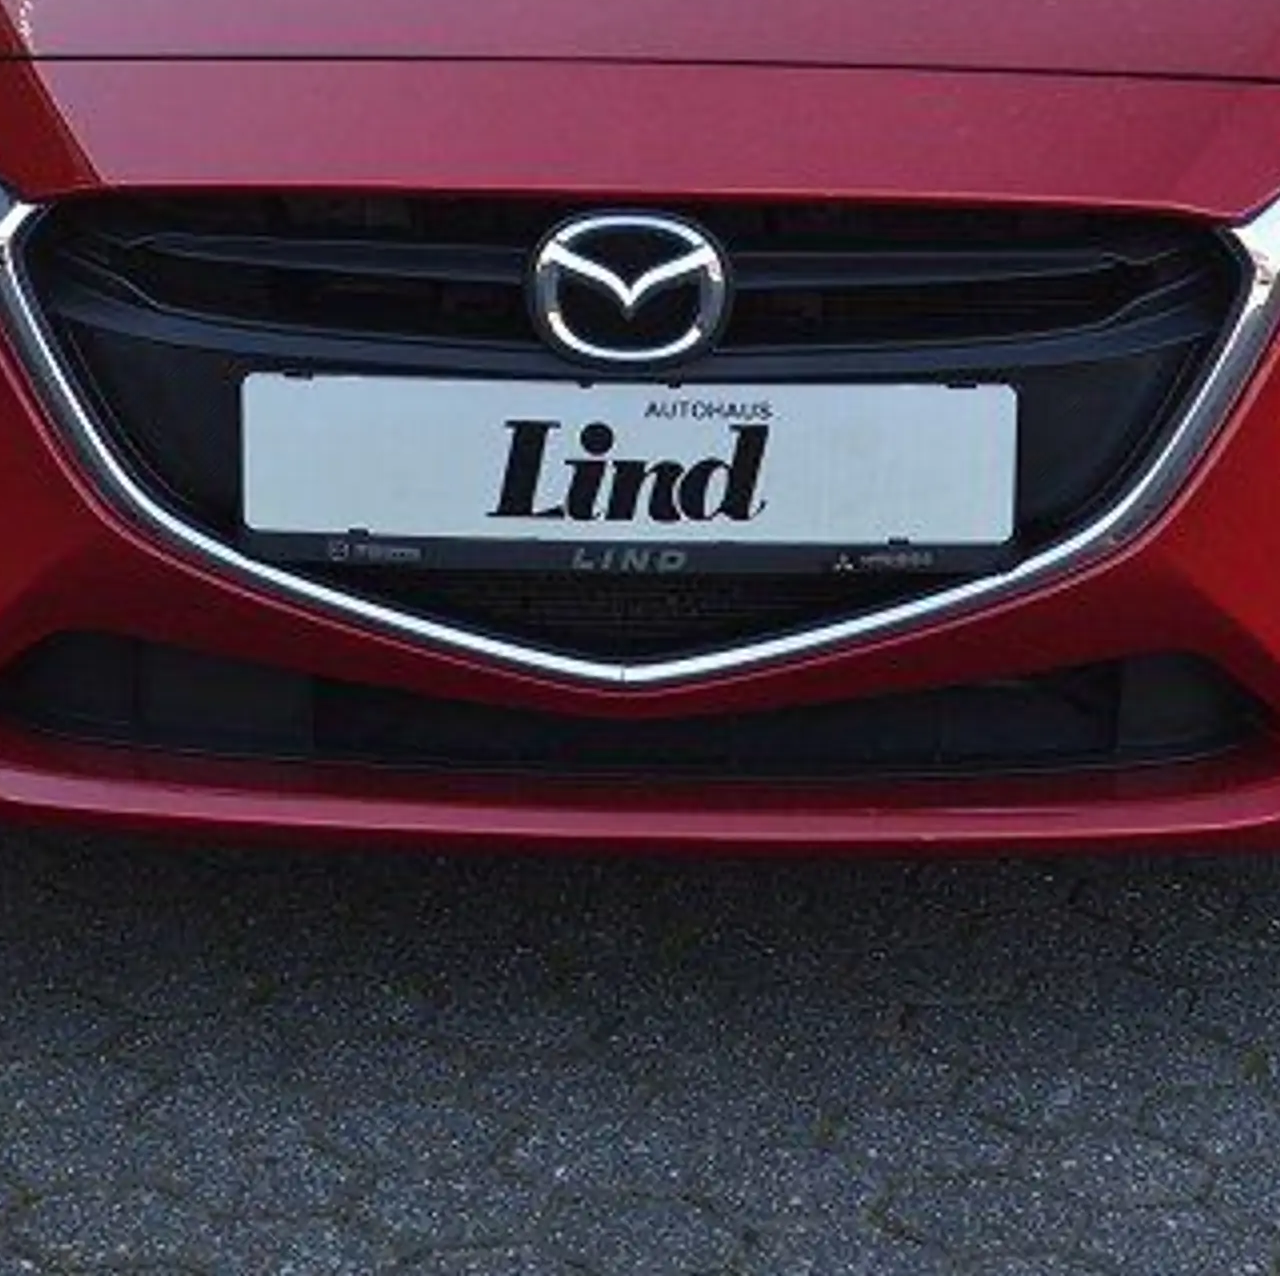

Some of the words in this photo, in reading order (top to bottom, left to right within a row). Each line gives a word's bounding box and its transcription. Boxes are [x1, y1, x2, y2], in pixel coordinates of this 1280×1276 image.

[644, 399, 773, 421] AUTOHAUS
[486, 420, 770, 522] Lind
[572, 547, 688, 572] LIND
